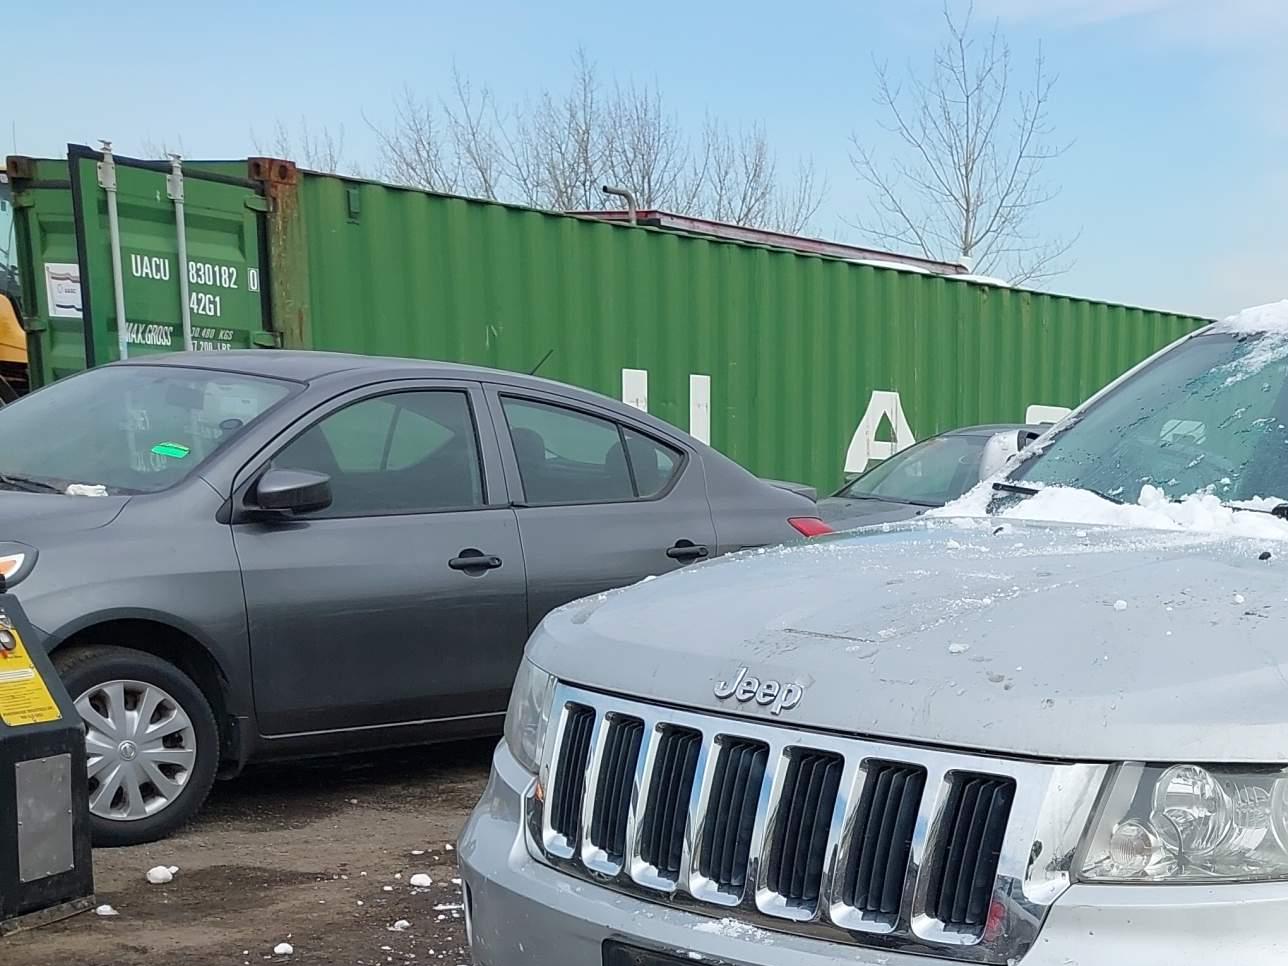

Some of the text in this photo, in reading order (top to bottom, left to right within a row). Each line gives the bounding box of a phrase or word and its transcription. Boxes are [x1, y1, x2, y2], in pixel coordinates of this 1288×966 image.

[130, 254, 258, 290] UACU 830182 0
[189, 292, 221, 317] 42G1
[713, 665, 805, 715] Jeep
